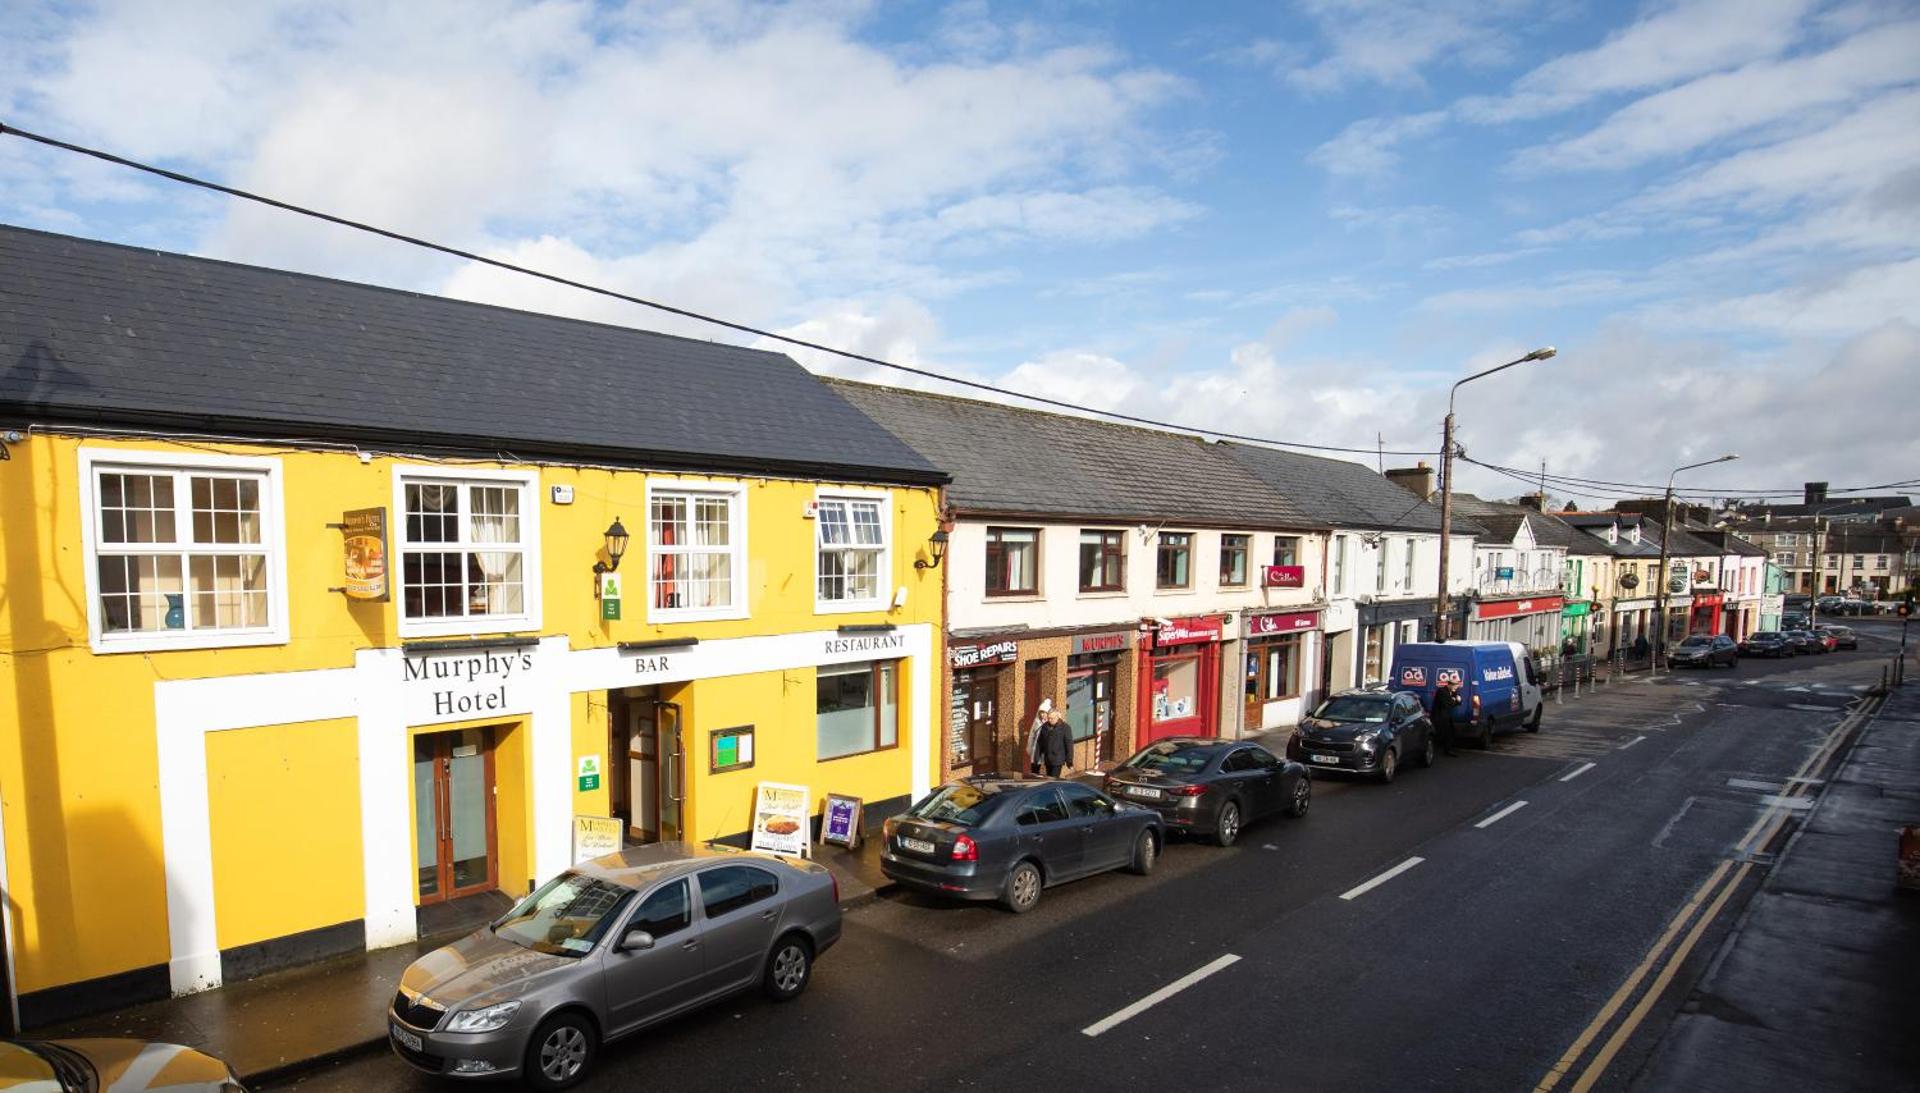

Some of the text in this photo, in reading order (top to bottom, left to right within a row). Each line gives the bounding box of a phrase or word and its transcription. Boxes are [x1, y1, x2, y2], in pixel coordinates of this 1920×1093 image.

[825, 635, 905, 654] RESTAURANT
[954, 651, 980, 667] SHOE
[980, 641, 1017, 660] REPAIRS
[402, 648, 532, 682] Murphy's
[635, 656, 669, 673] BAR
[433, 685, 507, 715] Hotel
